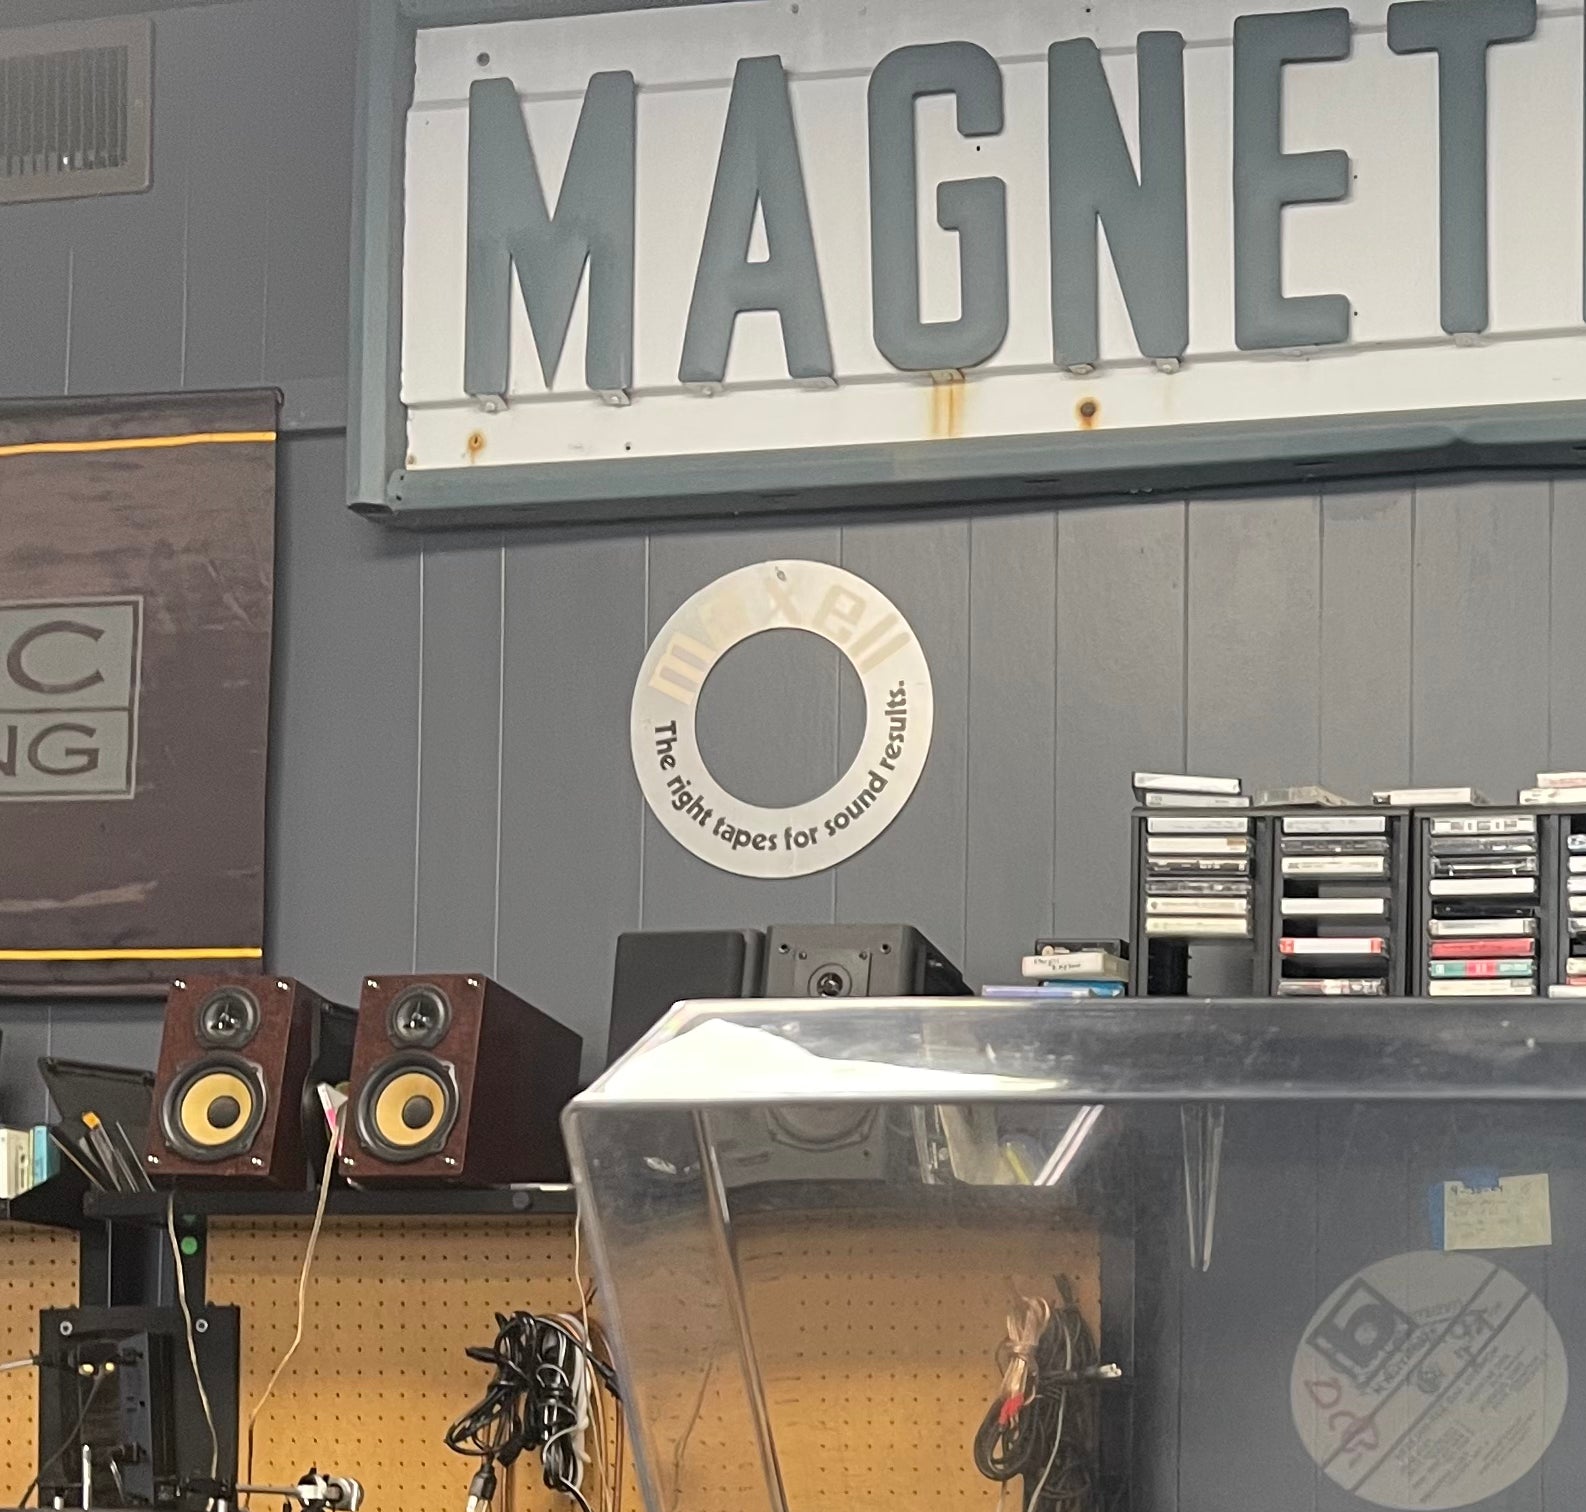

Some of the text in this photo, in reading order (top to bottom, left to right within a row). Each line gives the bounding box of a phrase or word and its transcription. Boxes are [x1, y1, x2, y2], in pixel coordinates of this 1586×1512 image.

[648, 573, 911, 706] mxell
[655, 680, 907, 851] The right tapes for sound results.
